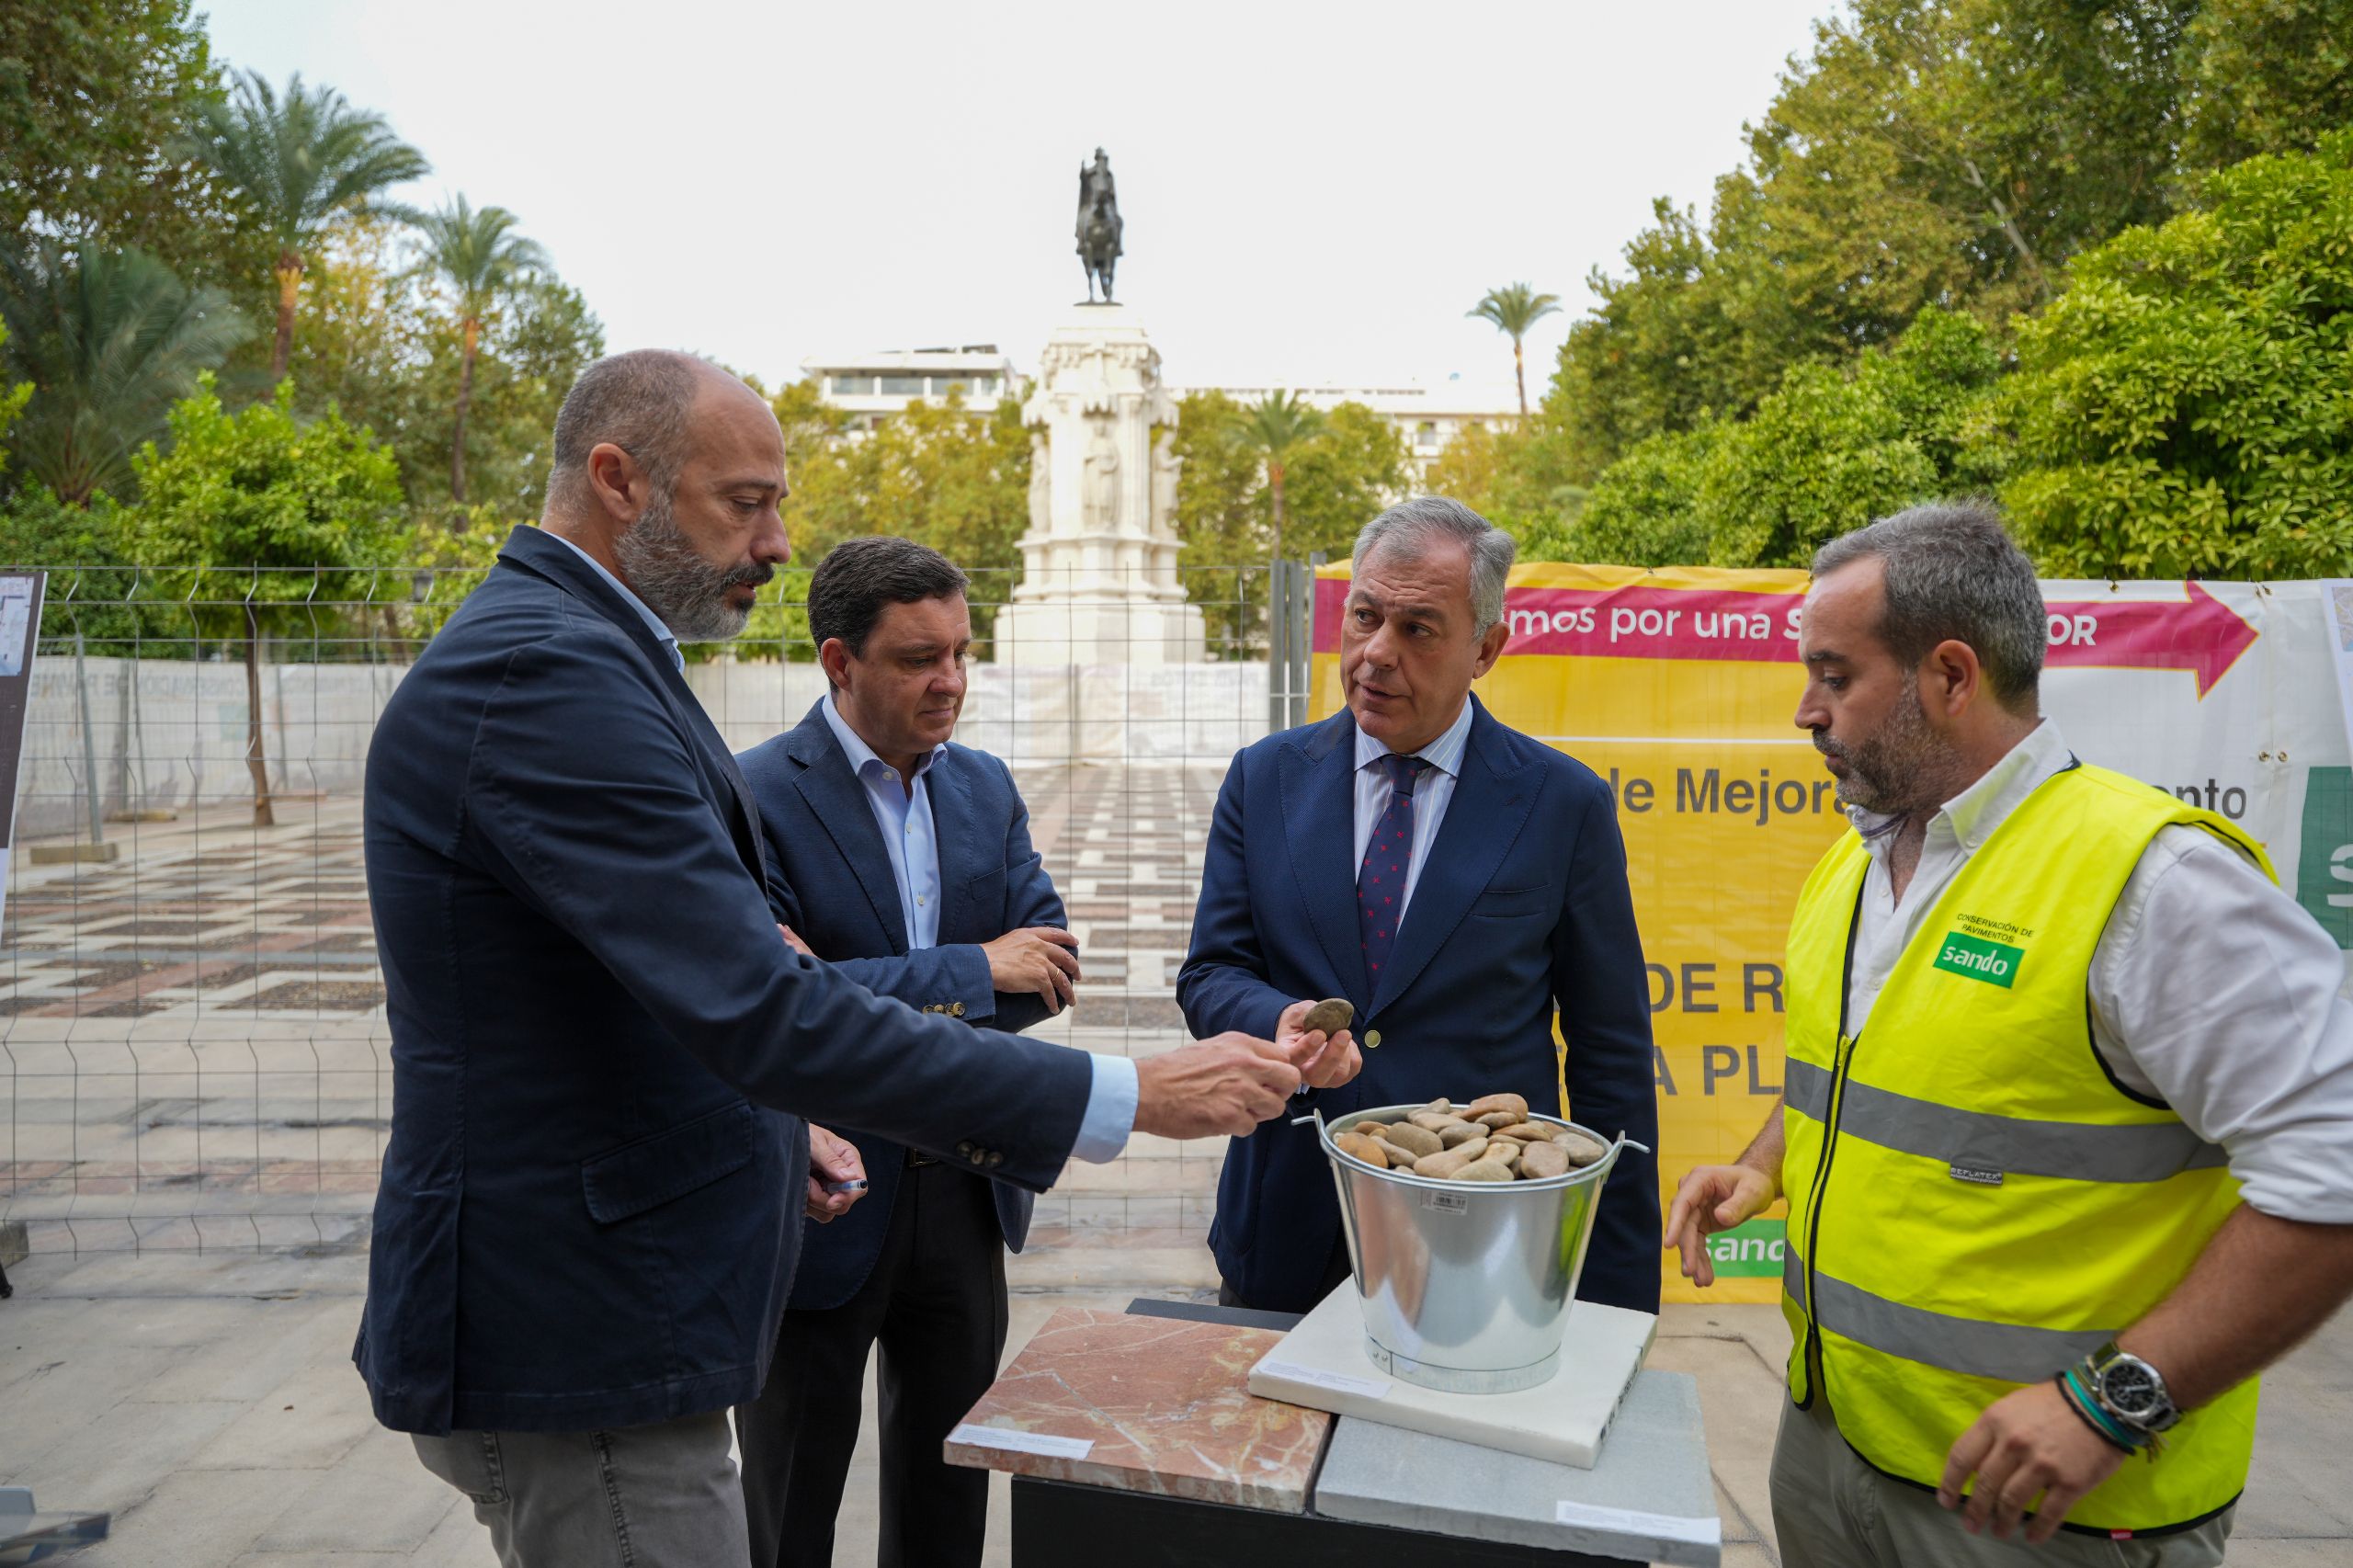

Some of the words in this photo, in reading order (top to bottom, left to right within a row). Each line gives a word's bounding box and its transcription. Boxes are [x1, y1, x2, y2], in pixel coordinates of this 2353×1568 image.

[1509, 608, 1596, 635] mos
[1610, 608, 1681, 643] por
[1695, 610, 1771, 640] una
[2046, 614, 2097, 646] OR
[1676, 767, 1847, 826] Mejor
[2020, 928, 2035, 938] DE
[1942, 946, 2008, 976] sando
[1702, 1045, 1784, 1096] PL
